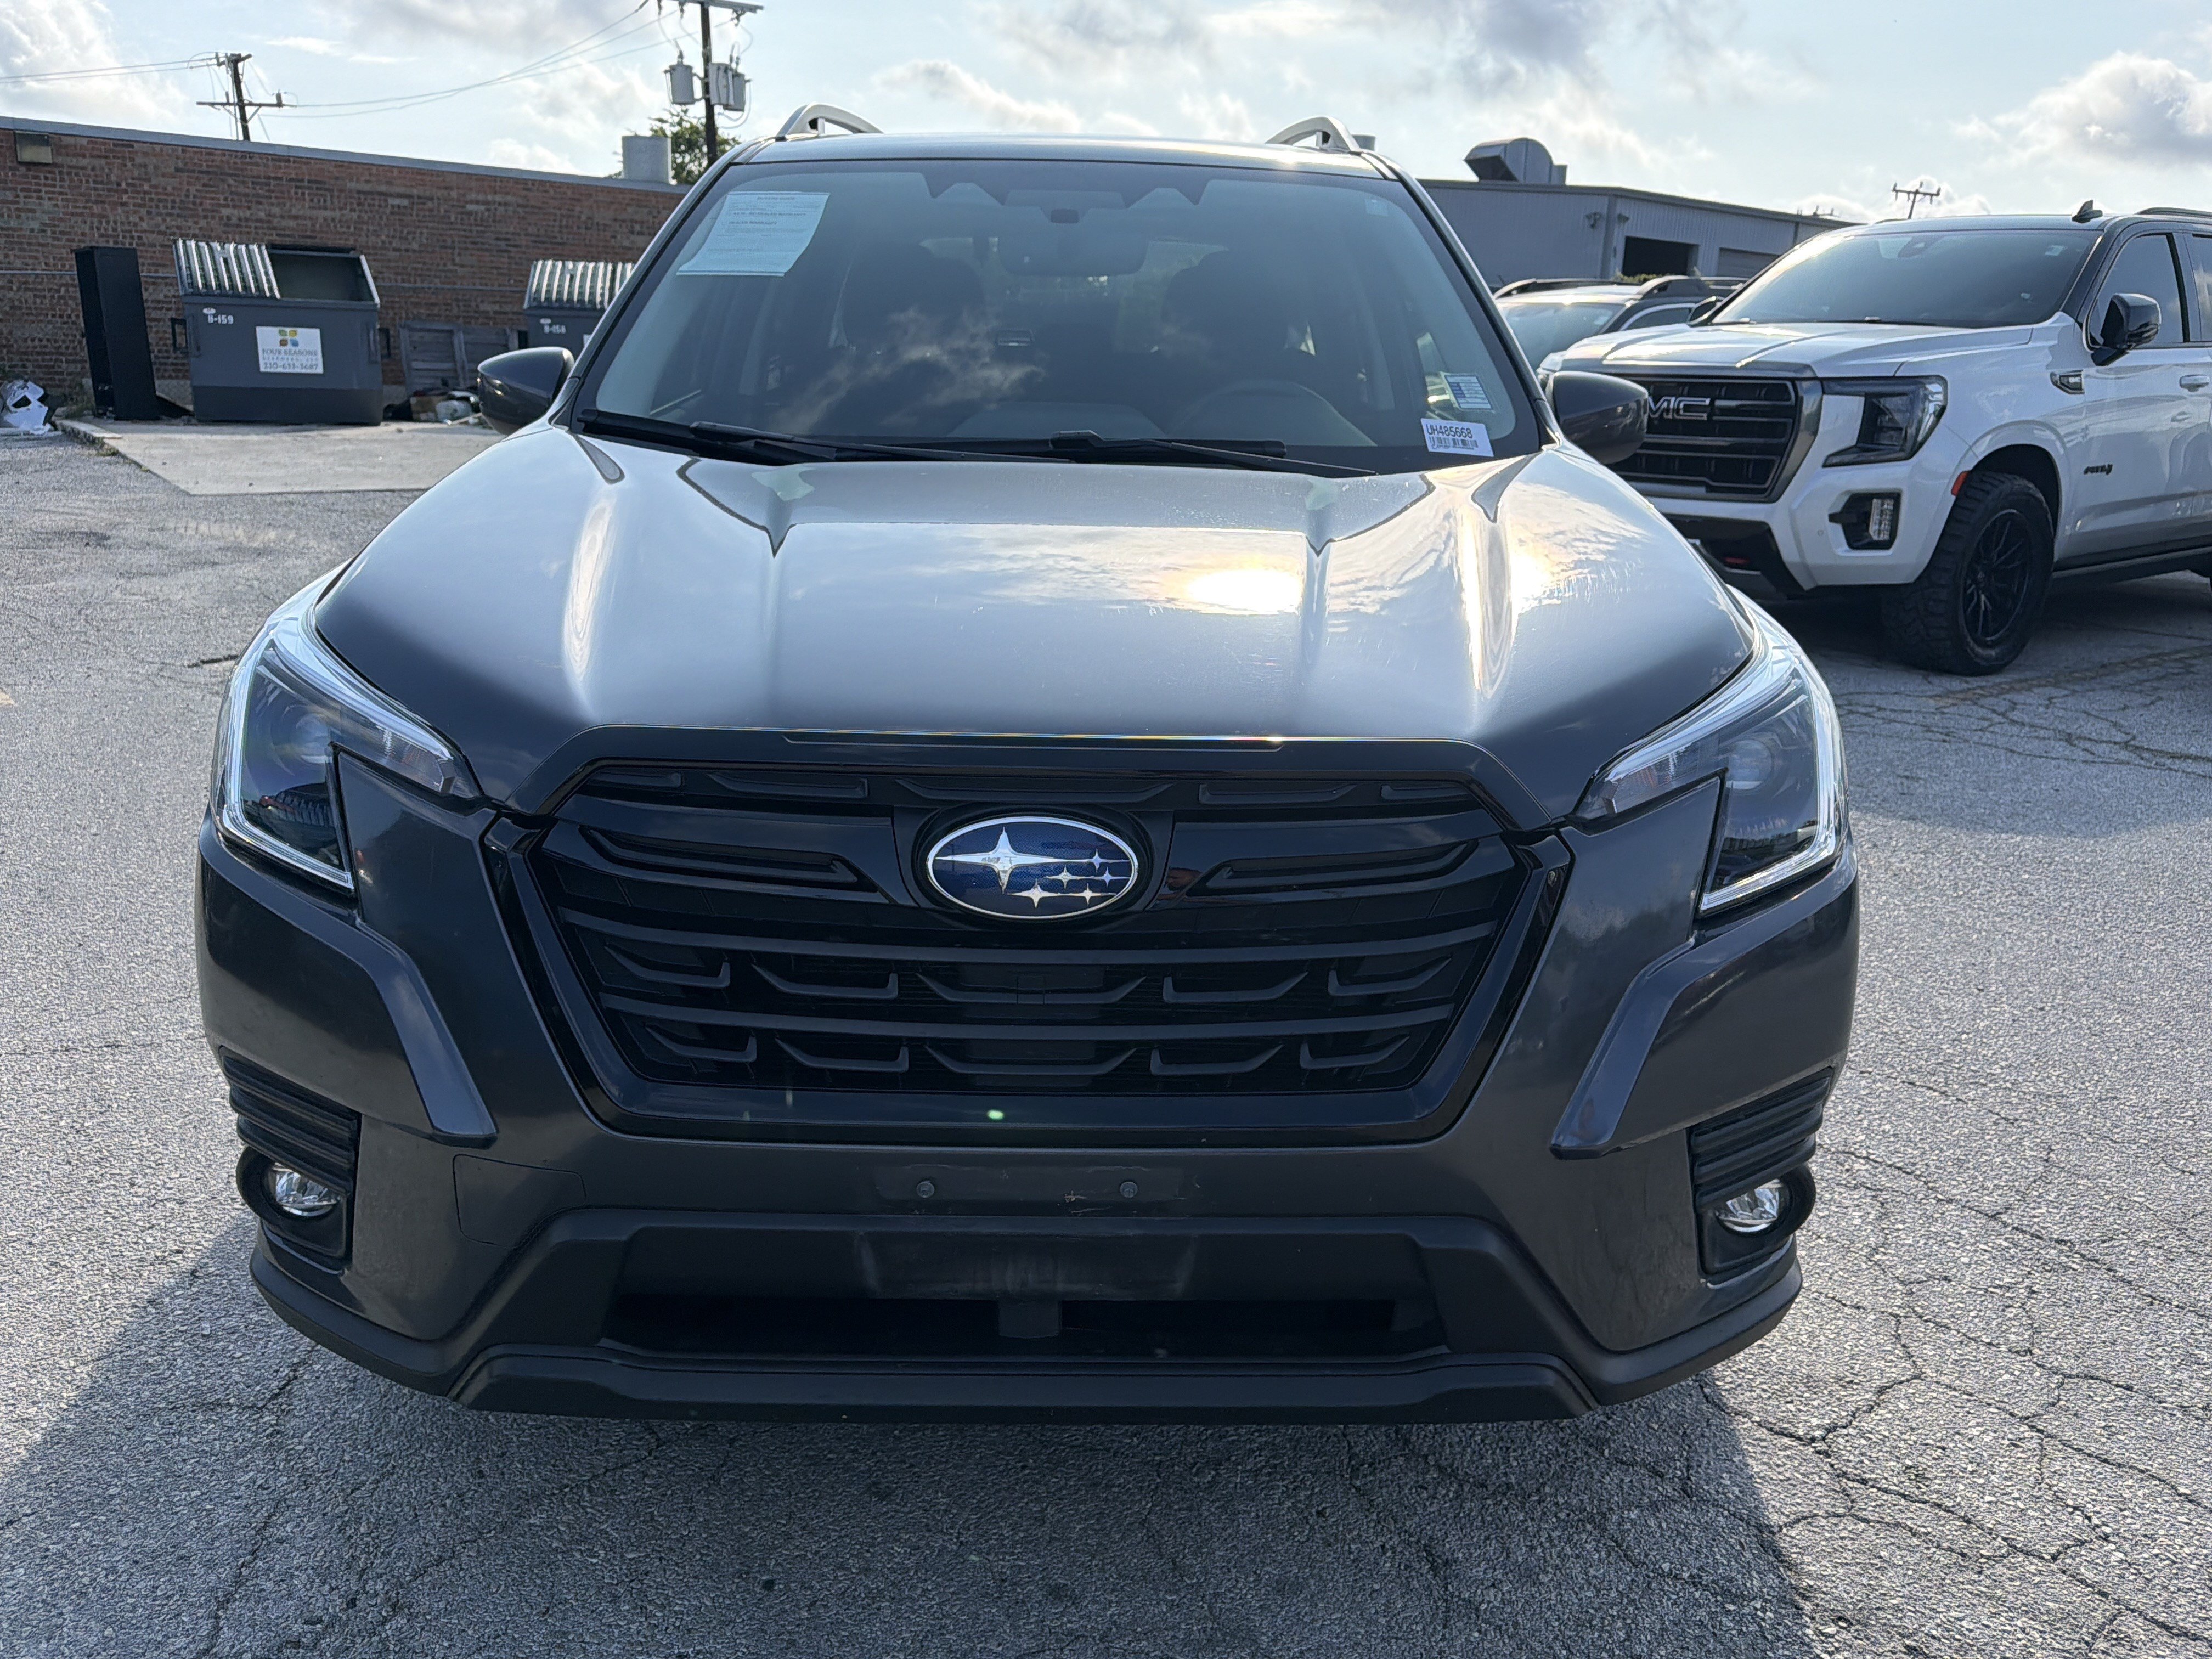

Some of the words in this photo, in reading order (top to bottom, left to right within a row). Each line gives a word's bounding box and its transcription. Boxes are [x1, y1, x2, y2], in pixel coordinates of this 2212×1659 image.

[283, 348, 318, 357] SEASONS
[1648, 396, 1711, 421] MC
[1426, 424, 1473, 439] UH485668
